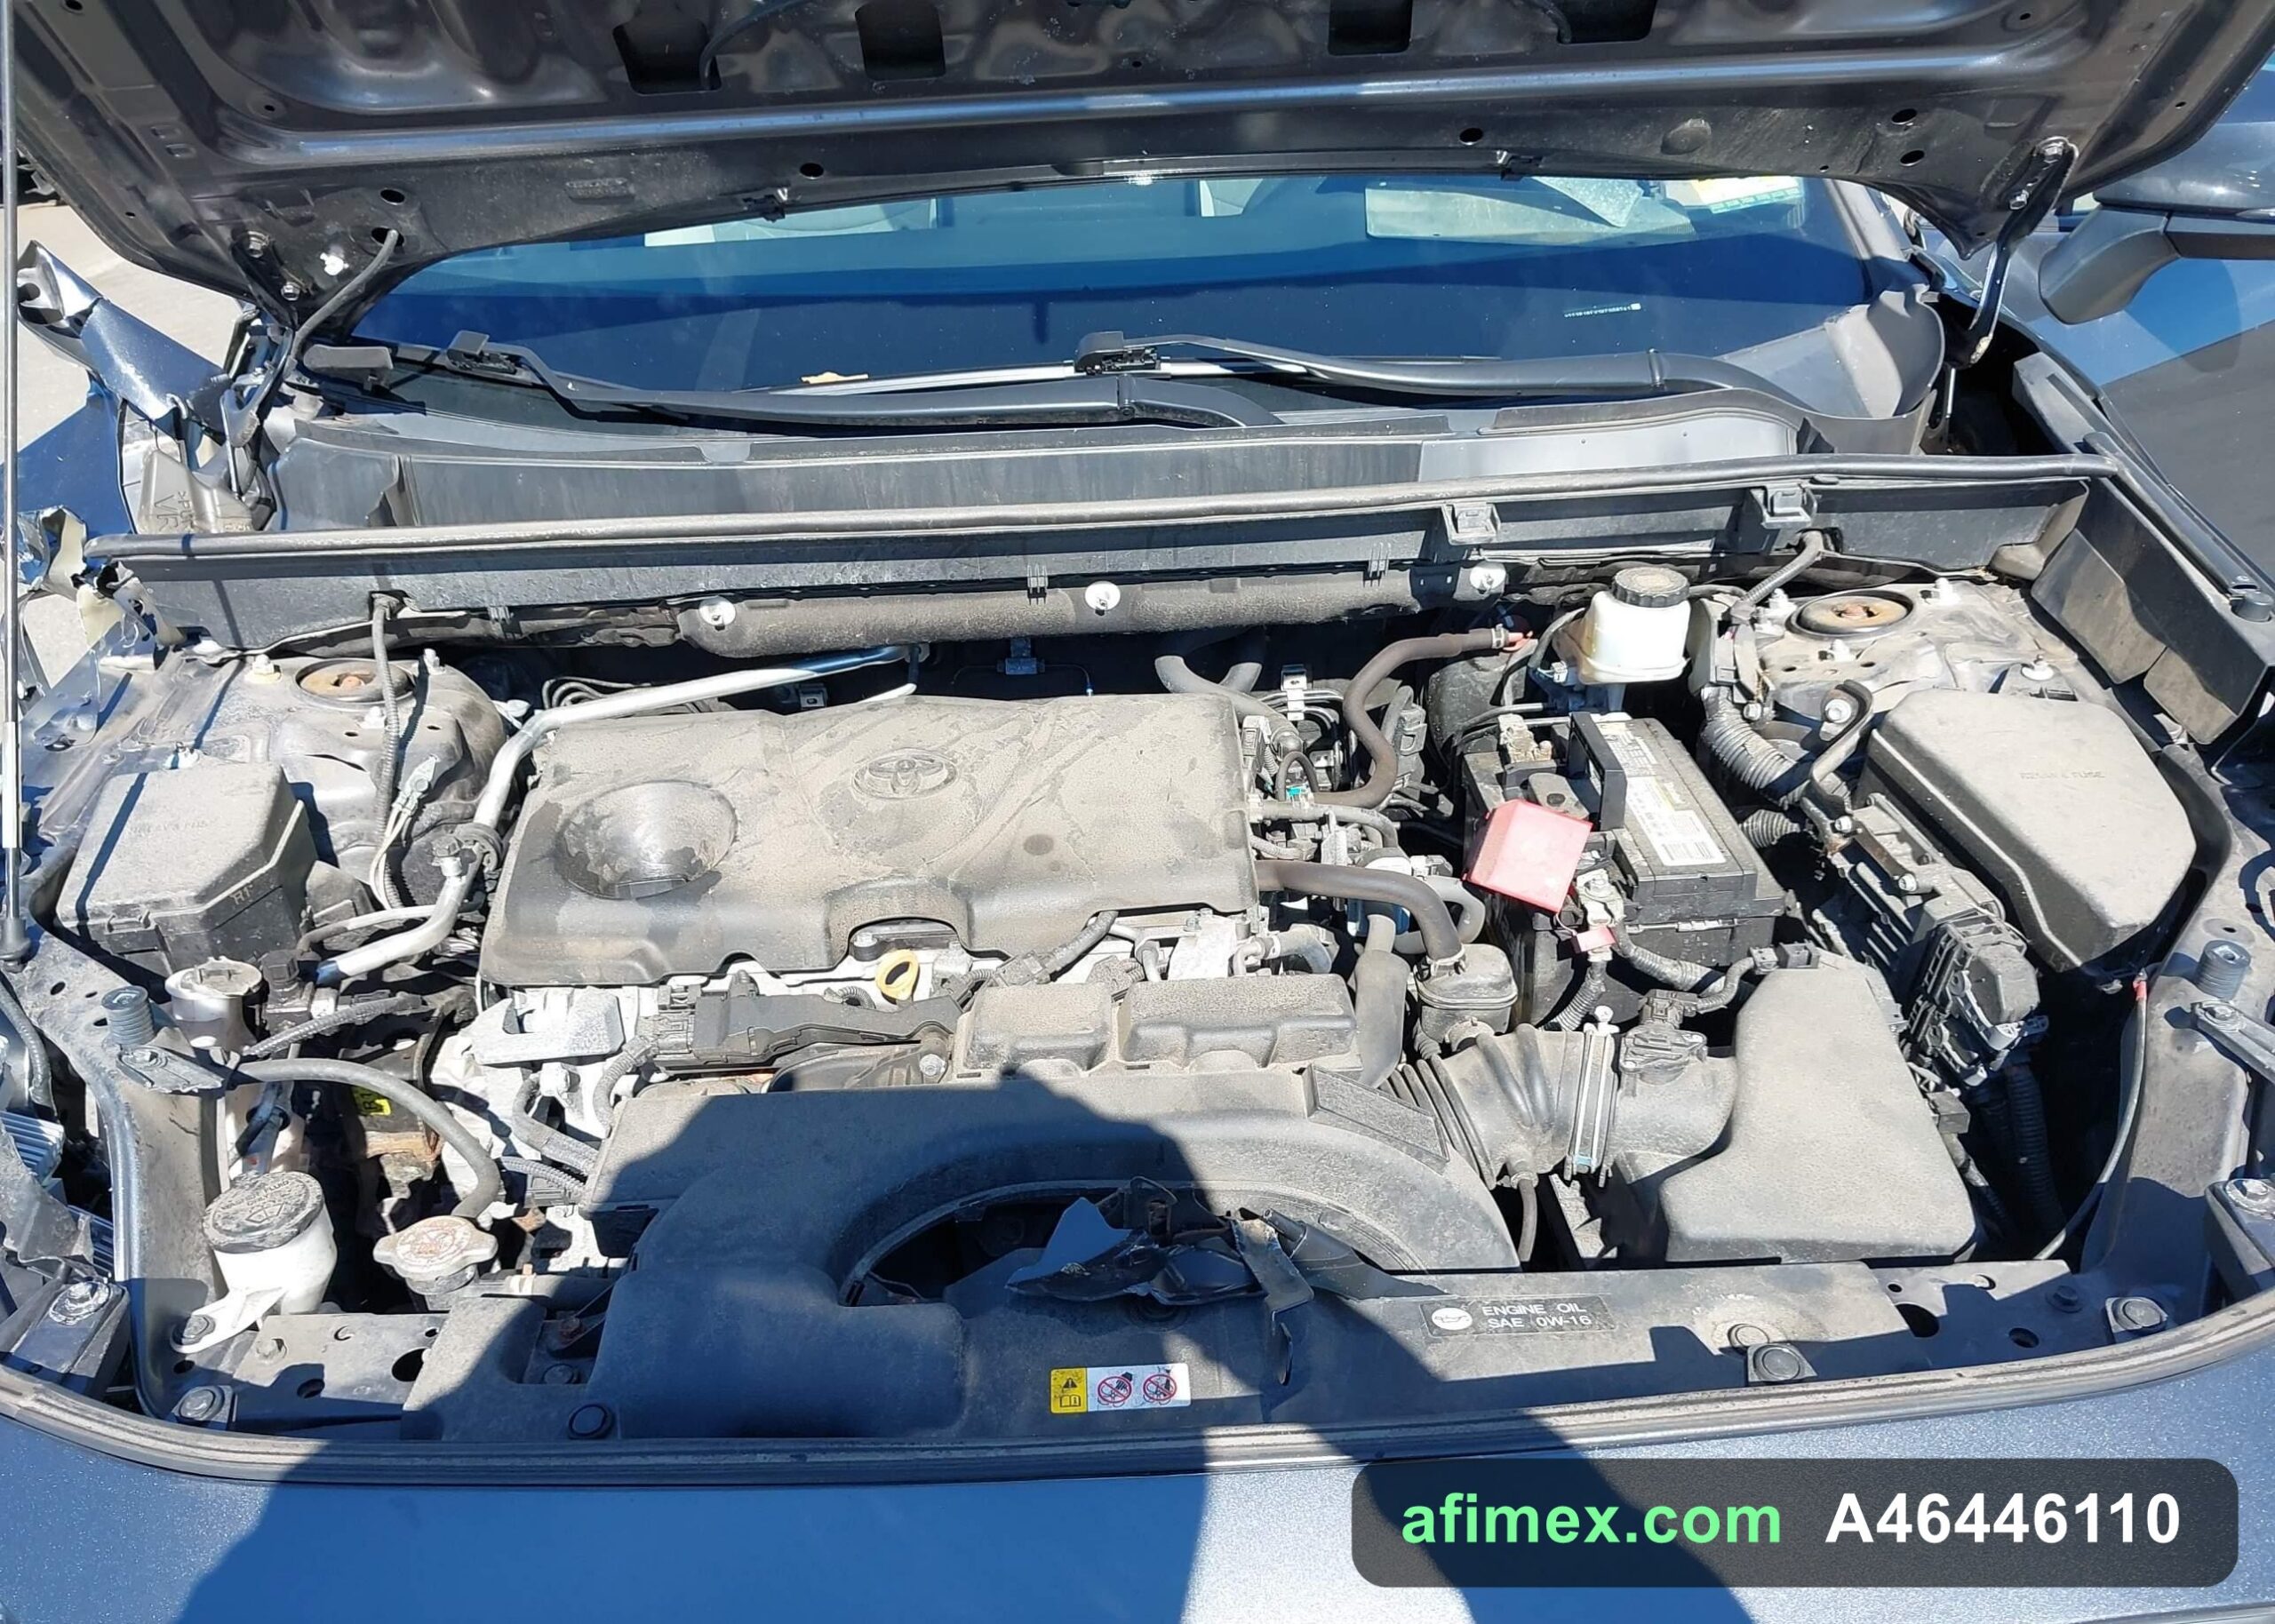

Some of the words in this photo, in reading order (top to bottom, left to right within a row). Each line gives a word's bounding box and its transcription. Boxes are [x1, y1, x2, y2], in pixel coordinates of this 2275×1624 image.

[1481, 1303, 1546, 1317] ENGINE
[1557, 1302, 1587, 1314] OIL
[1488, 1317, 1524, 1329] SAE
[1536, 1315, 1592, 1327] 0W-16
